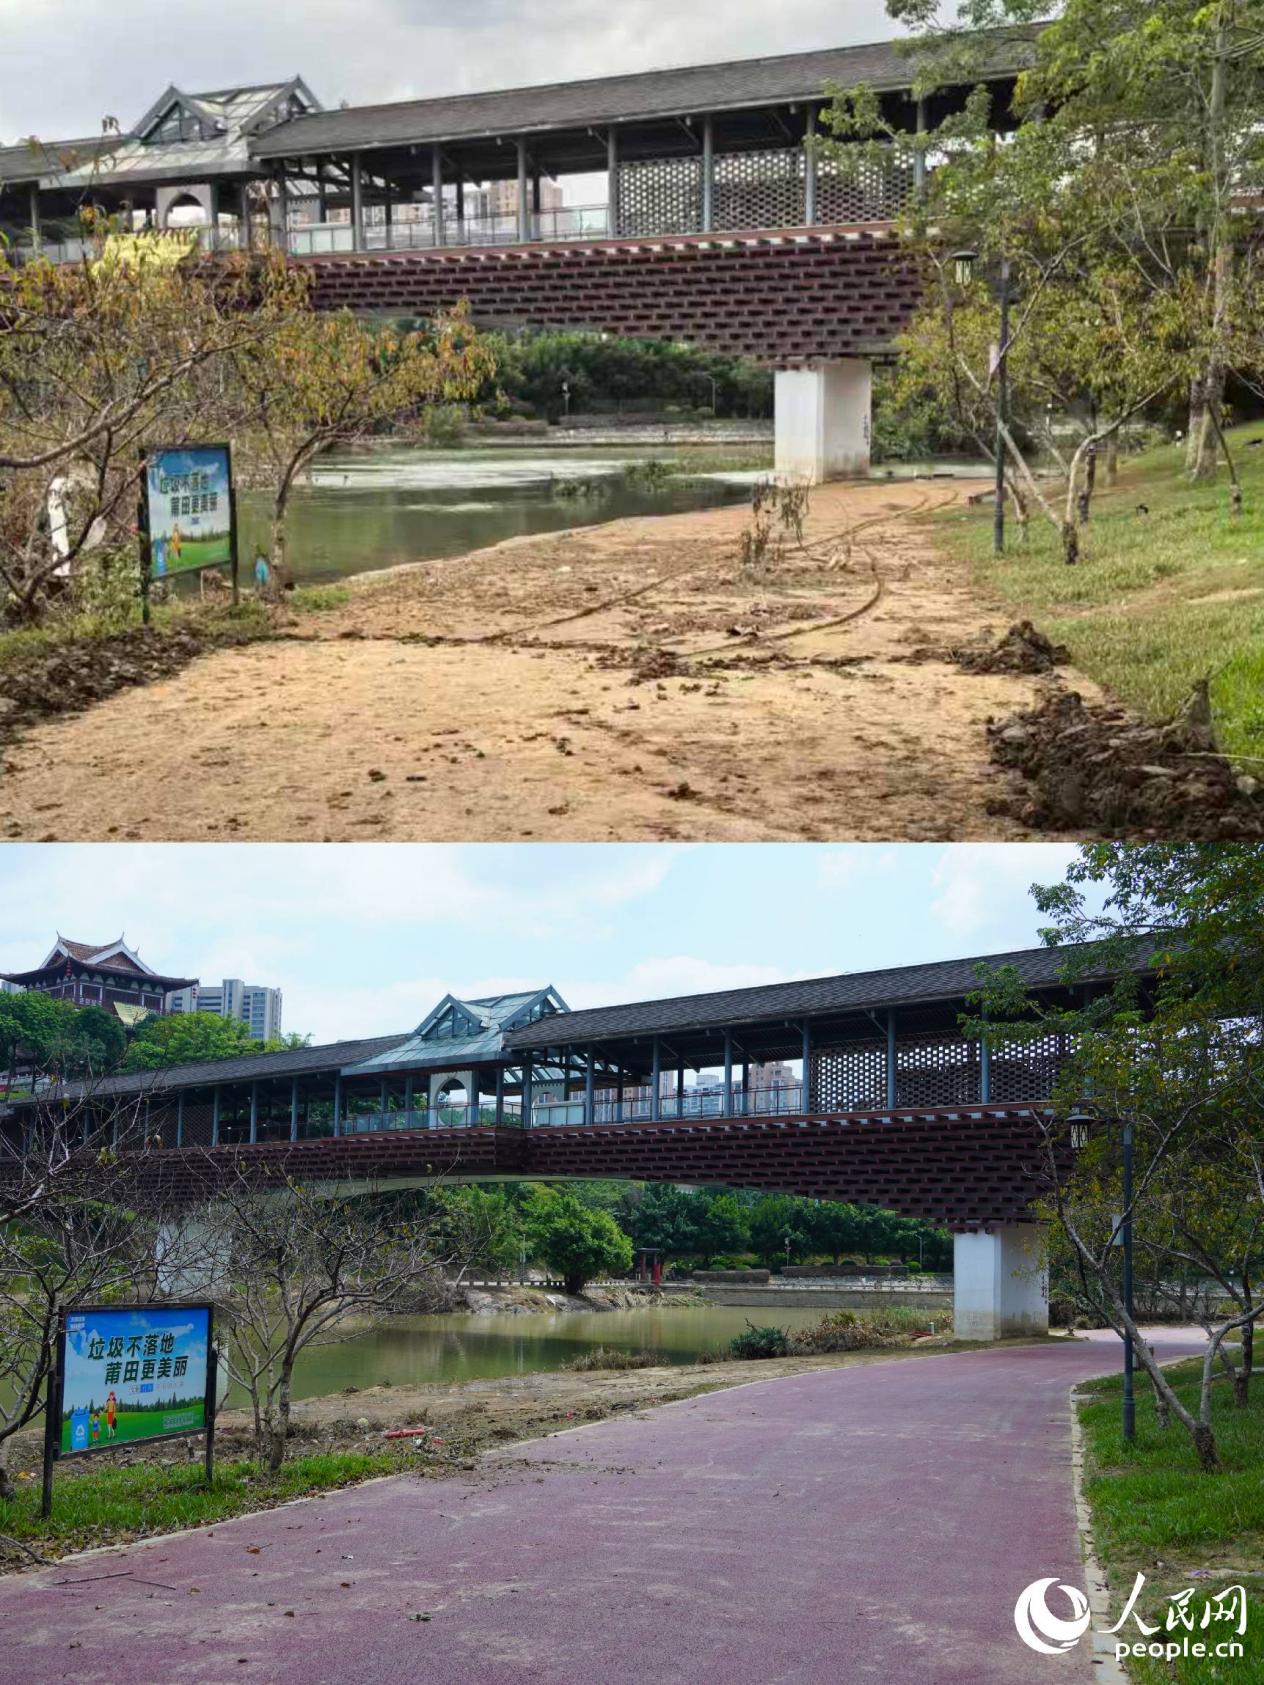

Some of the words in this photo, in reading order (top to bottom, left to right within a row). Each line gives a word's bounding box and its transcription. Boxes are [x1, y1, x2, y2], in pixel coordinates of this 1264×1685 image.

[87, 1332, 175, 1361] 垃圾不落地
[104, 1355, 189, 1385] 莆田更美丽
